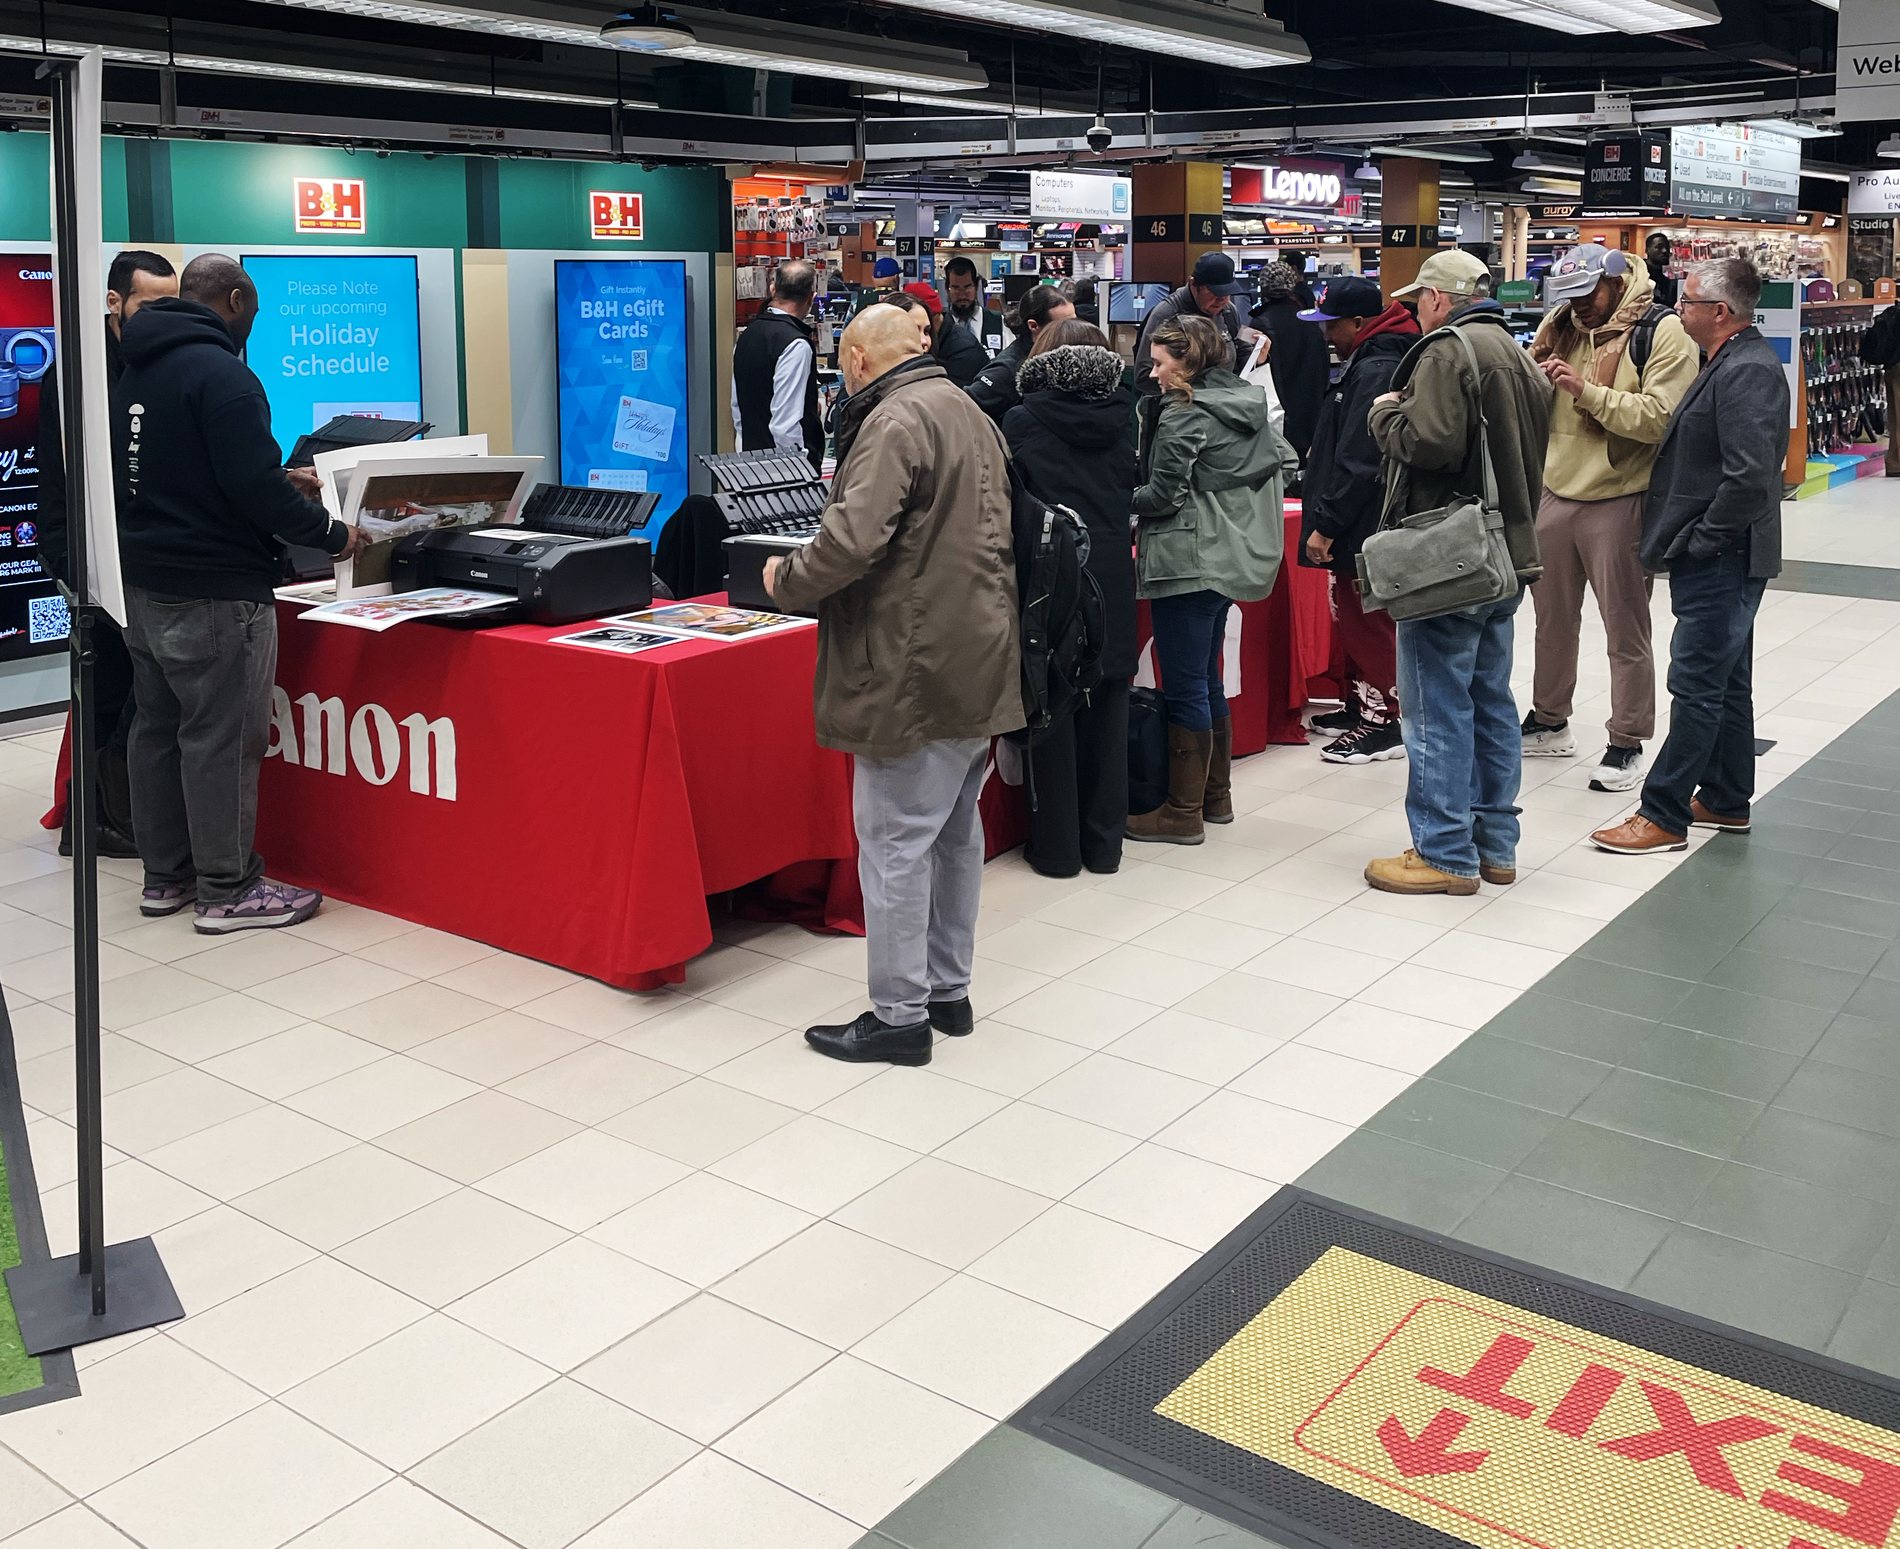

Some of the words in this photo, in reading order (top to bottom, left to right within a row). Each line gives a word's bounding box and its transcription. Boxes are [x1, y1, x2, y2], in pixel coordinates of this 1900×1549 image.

[1035, 176, 1073, 188] Computers
[1591, 167, 1632, 183] CONCIERGE
[1857, 176, 1878, 186] Pro
[1263, 168, 1340, 204] Lenovo
[297, 181, 361, 218] B&H
[593, 195, 640, 227] B&H
[1150, 221, 1166, 236] 46
[1201, 220, 1212, 236] 46
[1850, 219, 1889, 230] Studio
[1391, 229, 1406, 242] 47
[900, 241, 910, 252] 57
[923, 241, 931, 252] 57
[19, 269, 52, 280] Cano
[288, 281, 337, 296] Please
[342, 281, 379, 295] Note
[600, 285, 614, 294] Gift
[280, 303, 306, 316] our
[312, 301, 387, 318] upcoming
[580, 300, 618, 318] B&H
[623, 299, 665, 317] eGift
[291, 323, 379, 347] Holiday
[599, 320, 648, 339] Cards
[282, 352, 390, 378] Schedule
[264, 685, 456, 802] anon
[1414, 1332, 1900, 1547] EXIT
